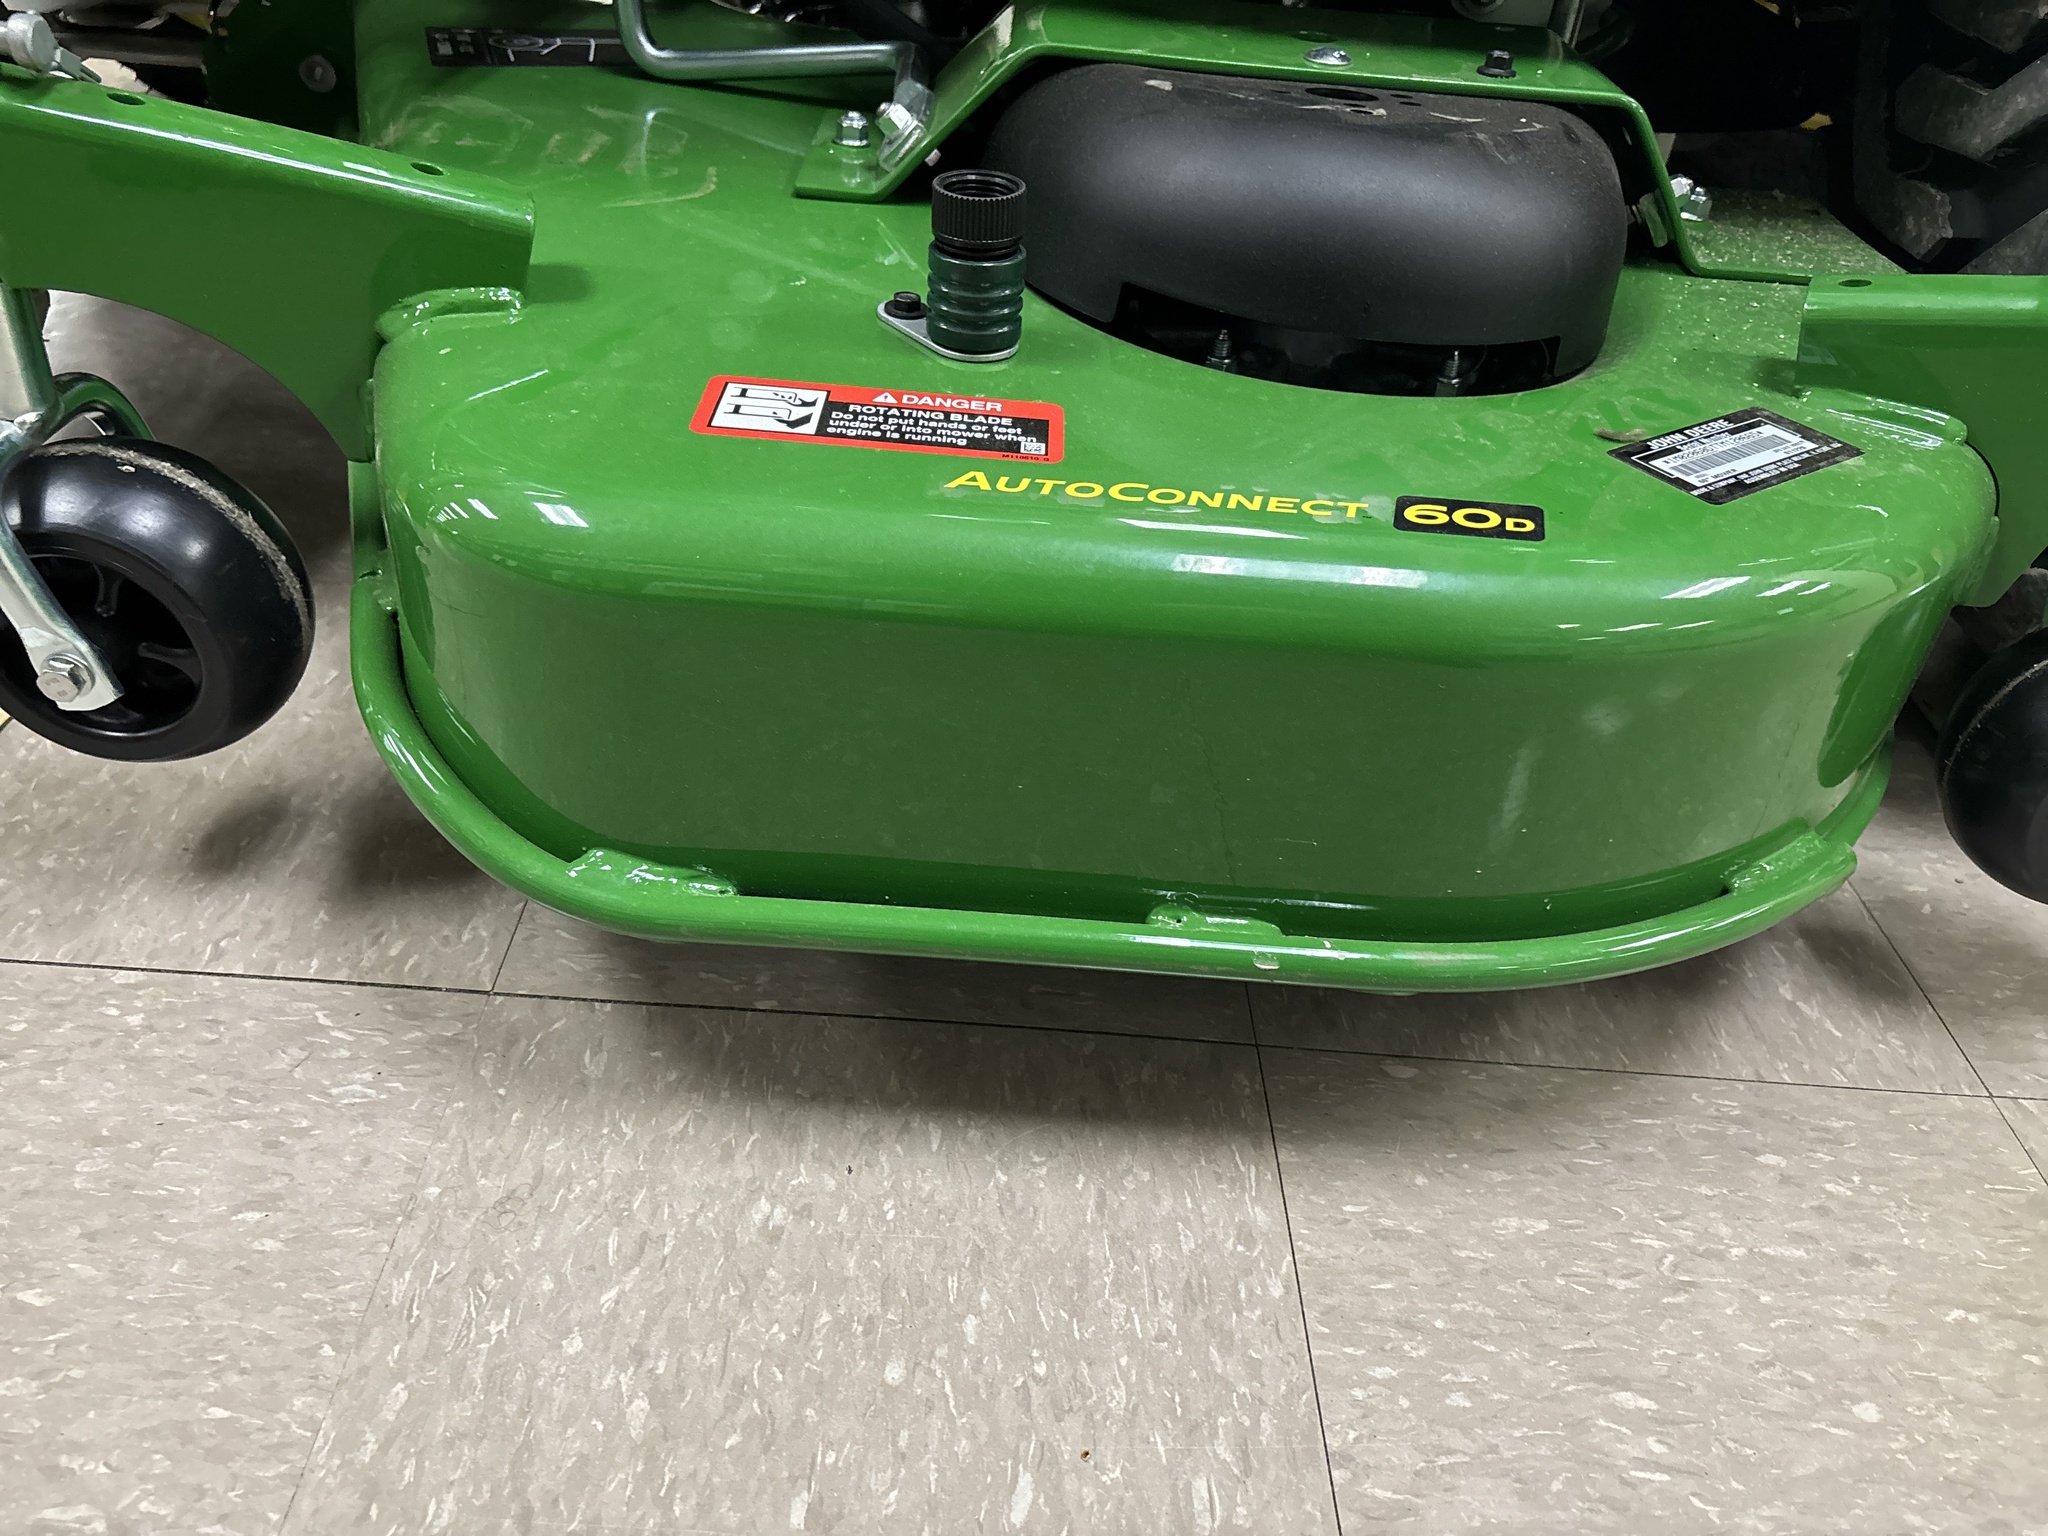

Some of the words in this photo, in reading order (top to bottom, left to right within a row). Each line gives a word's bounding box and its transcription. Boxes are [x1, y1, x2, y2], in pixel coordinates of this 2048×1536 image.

[902, 394, 1002, 412] DANGER
[849, 404, 944, 420] ROTATING
[950, 413, 1012, 425] BLADE
[858, 414, 884, 422] not
[888, 417, 914, 426] put
[919, 418, 966, 430] hands
[971, 424, 988, 432] or
[992, 425, 1022, 435] feet
[826, 426, 881, 439] engine
[886, 430, 900, 439] is
[905, 433, 967, 445] running
[829, 419, 876, 429] under
[902, 425, 932, 434] into
[937, 429, 989, 439] mower
[994, 432, 1036, 443] when
[1647, 433, 1688, 450] JOHN
[1684, 419, 1734, 437] DEERE
[945, 471, 1368, 518] AUTOCONNECT
[1403, 505, 1535, 532] 60D
